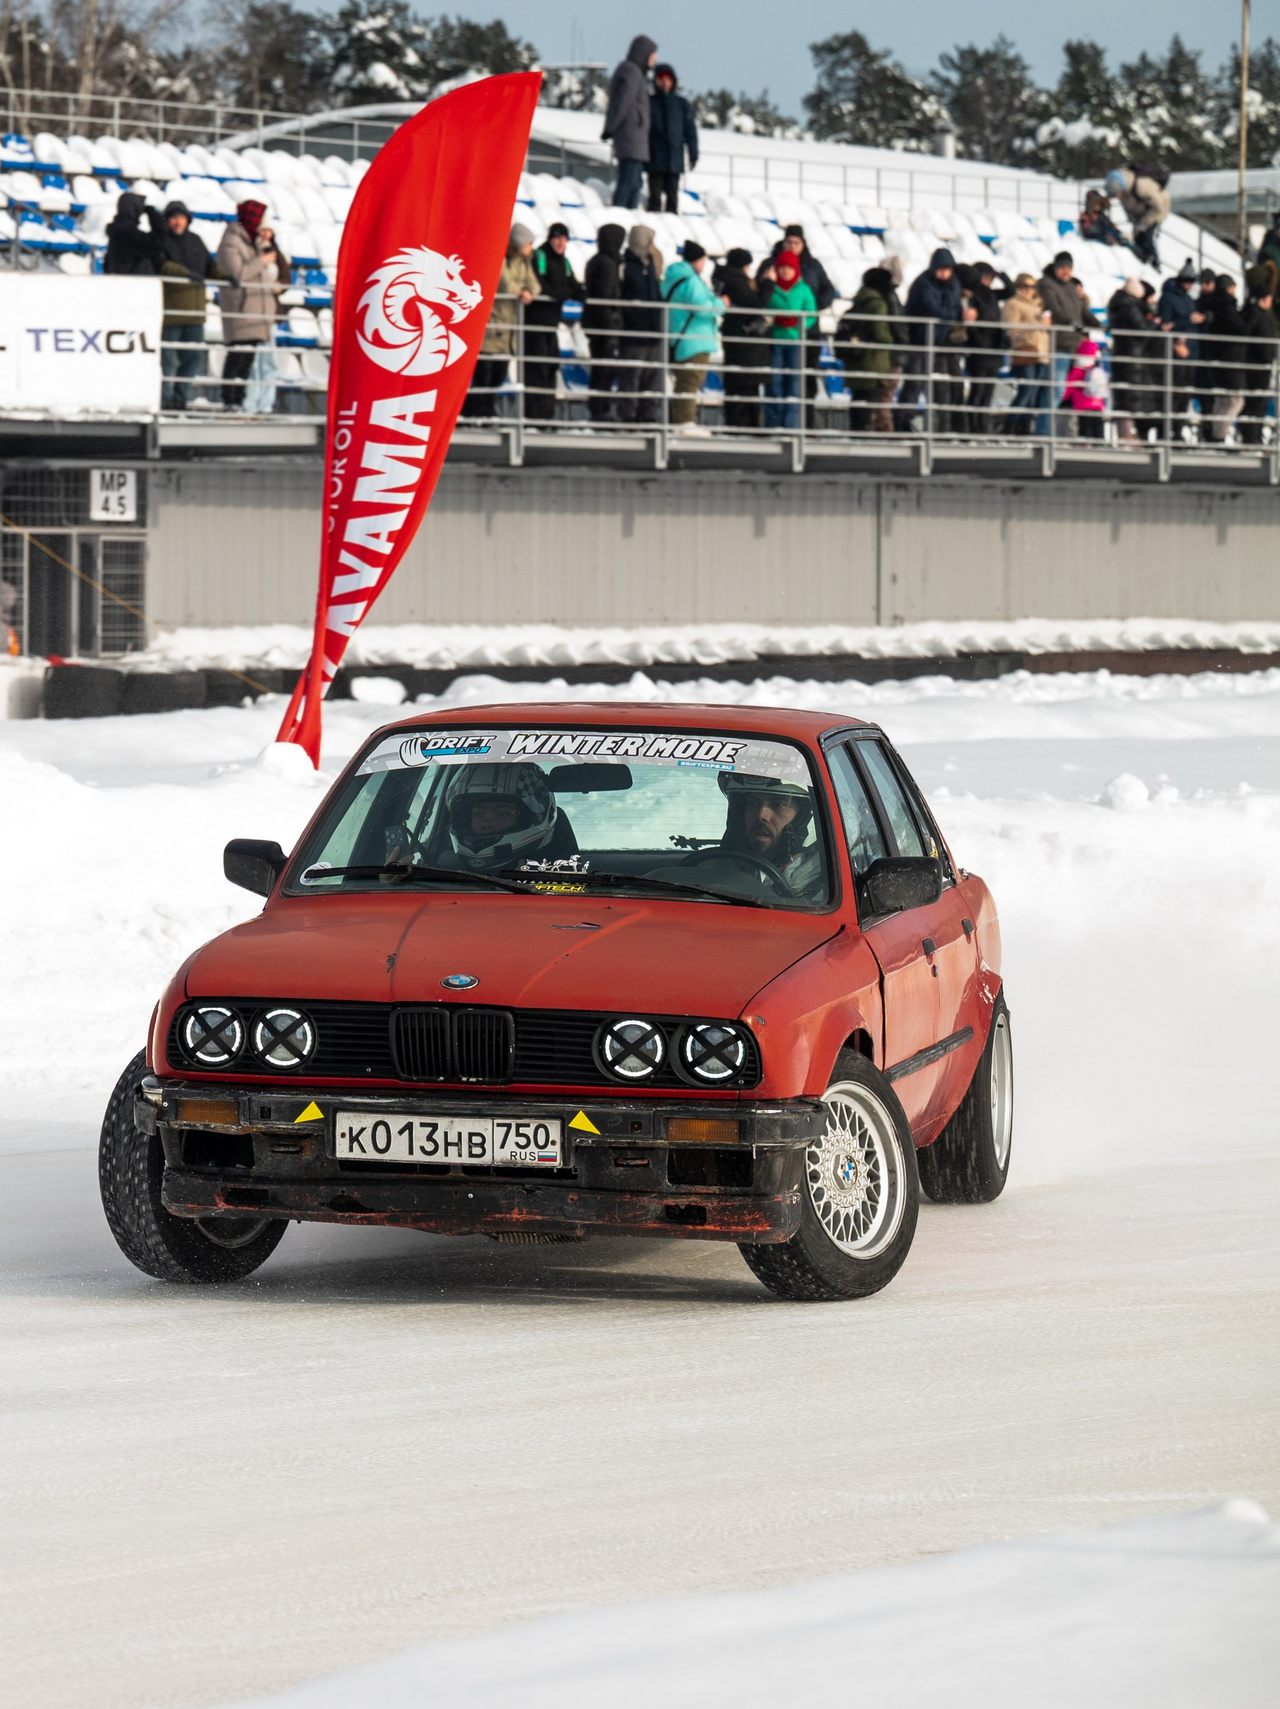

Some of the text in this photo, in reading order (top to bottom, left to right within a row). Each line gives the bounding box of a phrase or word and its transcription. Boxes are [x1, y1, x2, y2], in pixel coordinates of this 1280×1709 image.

[26, 328, 156, 355] TEXOL
[334, 401, 358, 450] OIL
[101, 496, 127, 515] 4.5
[425, 735, 497, 751] DRIFT
[506, 734, 748, 763] WINTER MODE
[680, 761, 733, 770] DRIFTEXPO.RU
[496, 1122, 551, 1150] 750
[509, 1151, 537, 1162] RUS
